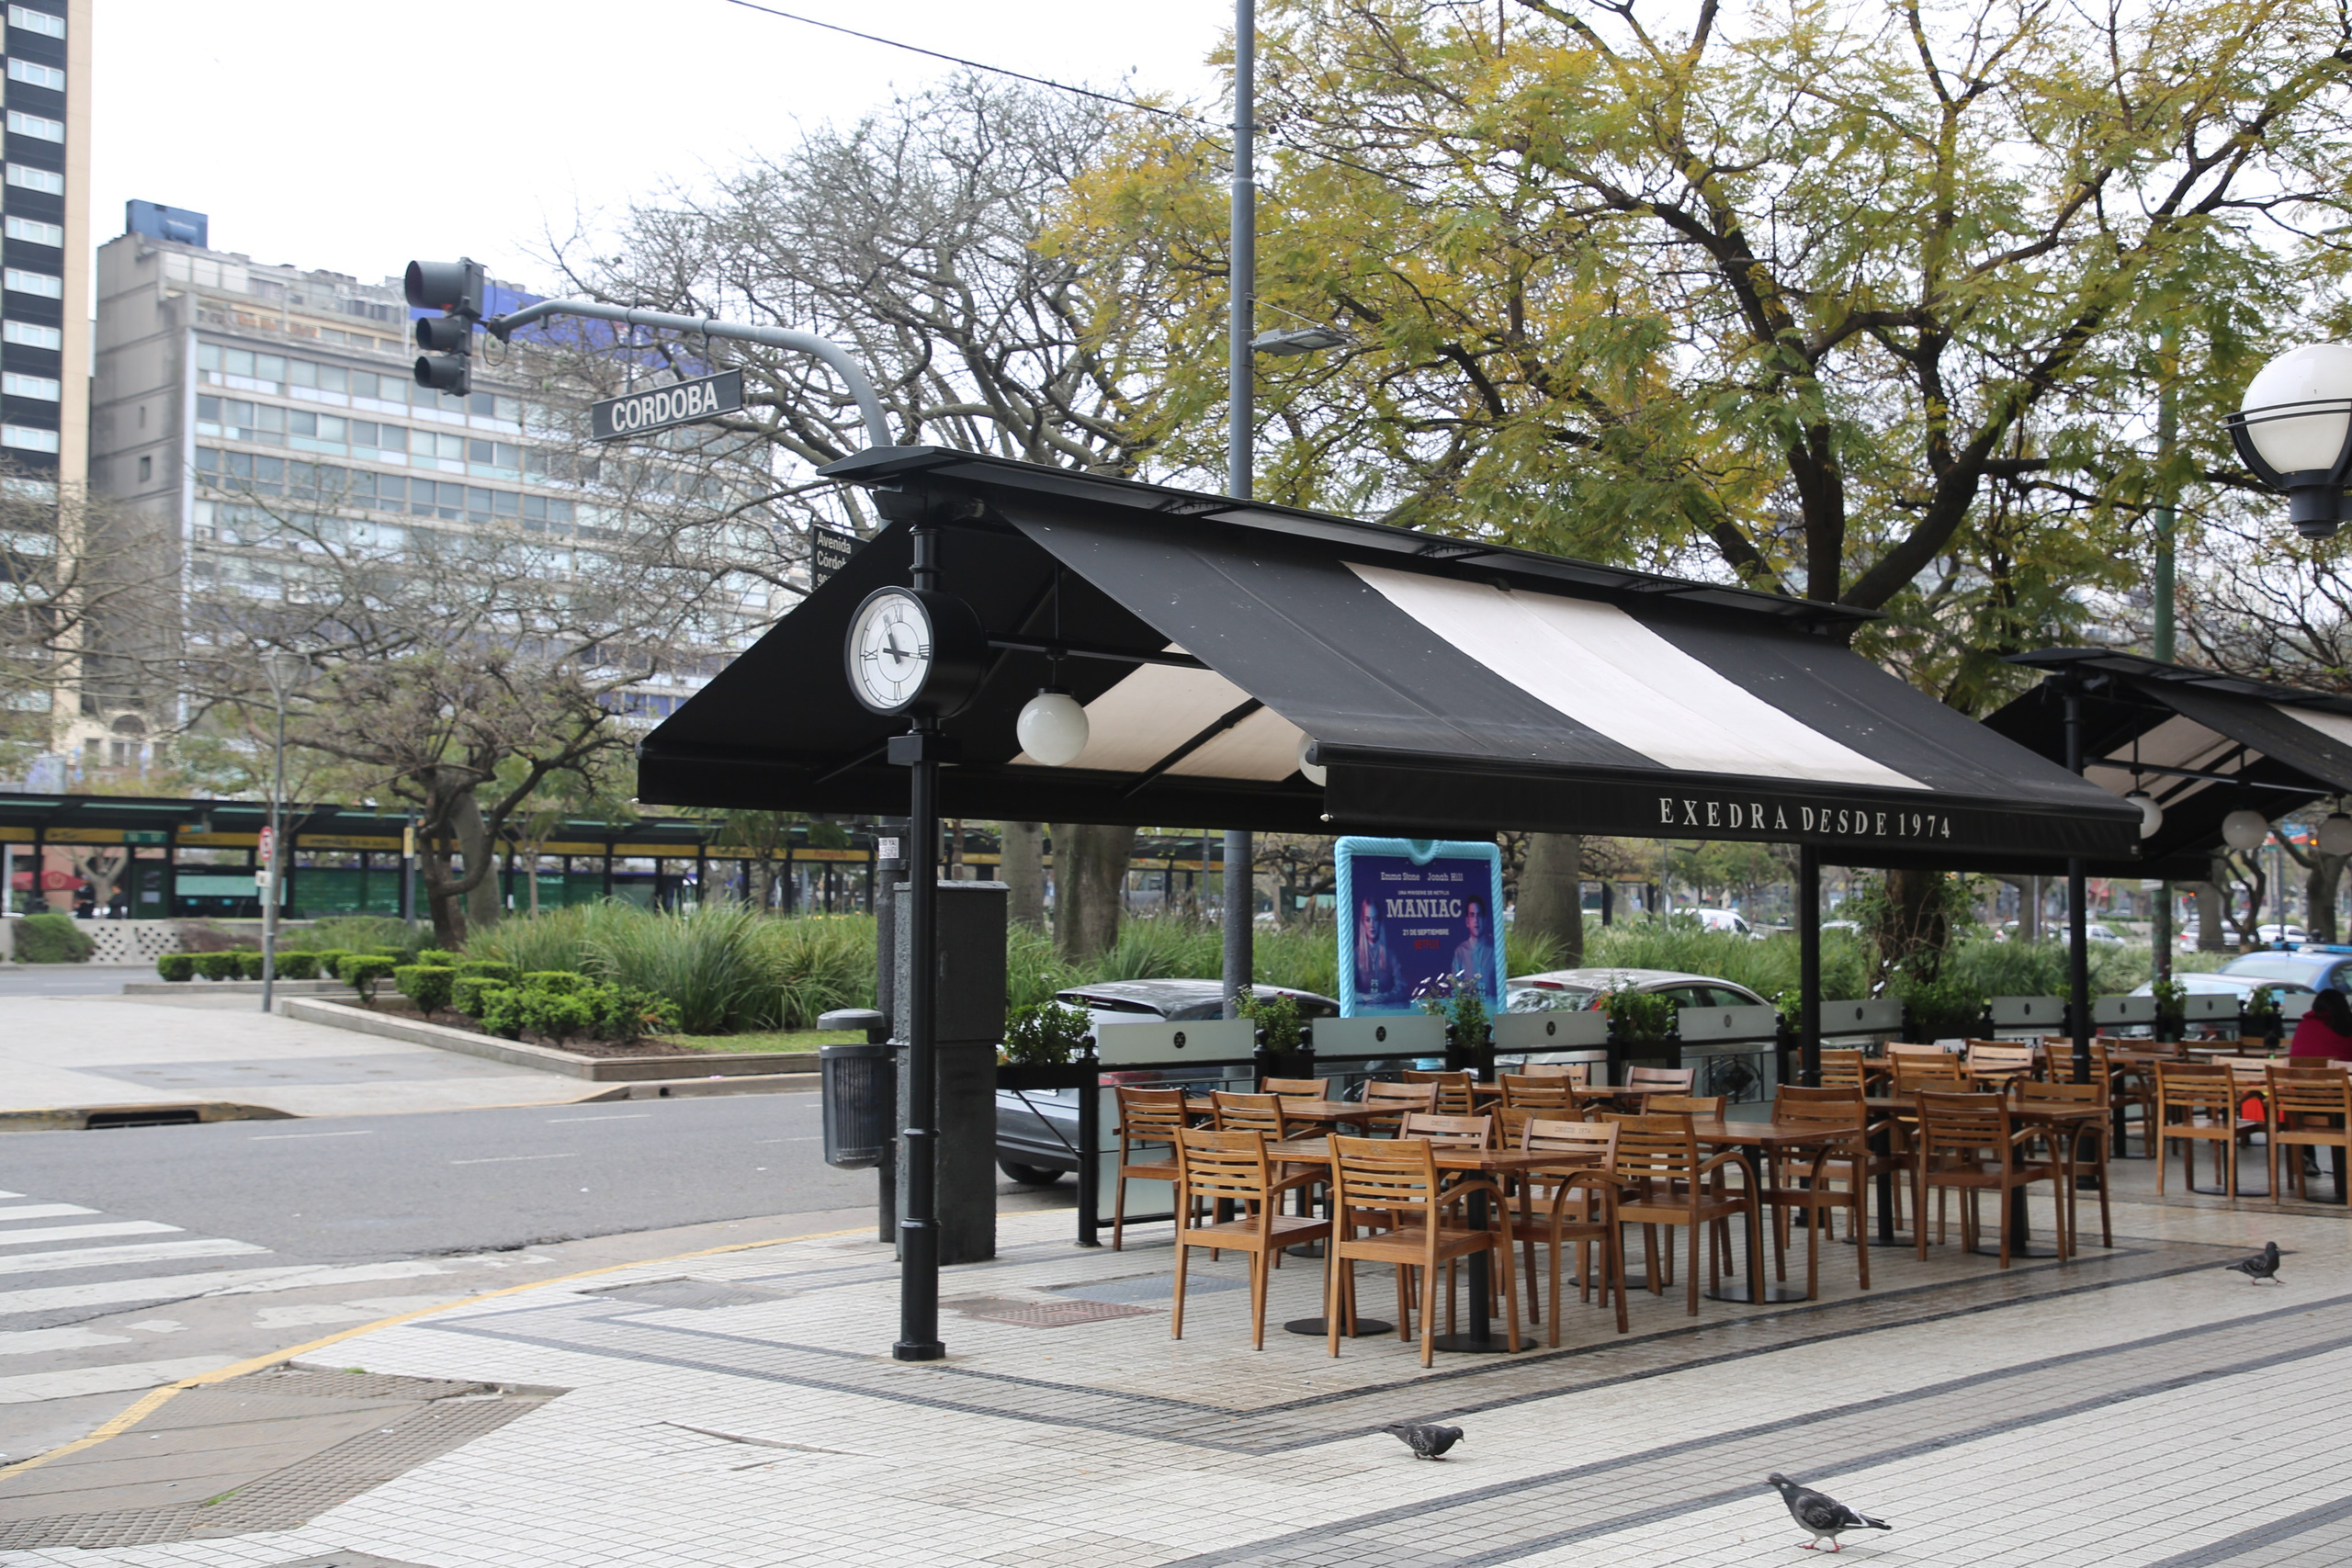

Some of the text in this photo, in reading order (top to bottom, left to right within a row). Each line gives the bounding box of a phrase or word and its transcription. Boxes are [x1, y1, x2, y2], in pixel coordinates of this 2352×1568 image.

[611, 381, 719, 432] CORDOBA
[817, 530, 852, 554] Avenida
[1658, 797, 1951, 839] EXEDRA DESDE 1974
[1381, 872, 1464, 882] Emma Stone Jonah Hill
[1385, 898, 1463, 918] MANIAC
